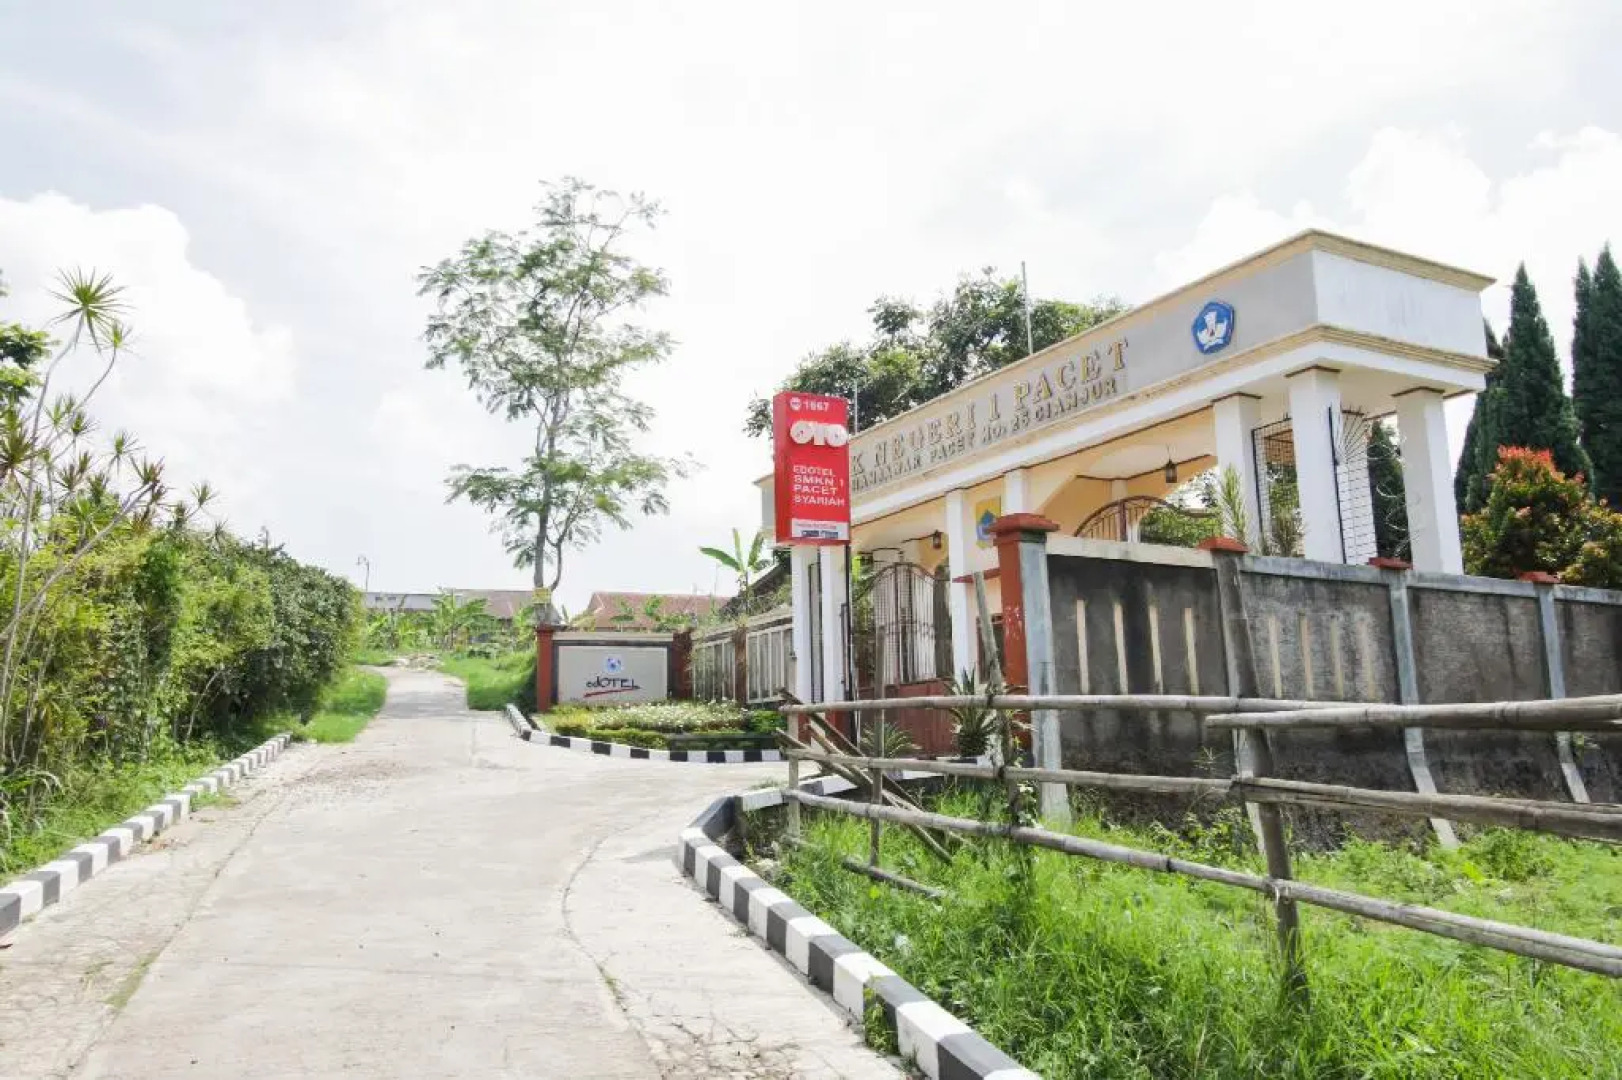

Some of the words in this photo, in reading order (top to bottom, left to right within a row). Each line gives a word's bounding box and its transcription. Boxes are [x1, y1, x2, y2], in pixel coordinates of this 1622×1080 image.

[875, 401, 976, 468] NEGERI
[1013, 336, 1129, 410] PACET
[930, 431, 975, 463] PACET
[1035, 376, 1118, 421] CIANJUR
[793, 465, 835, 476] EDOTEL
[794, 474, 834, 486] SMKN
[794, 484, 837, 496] PACET
[794, 494, 845, 507] SYARIAH
